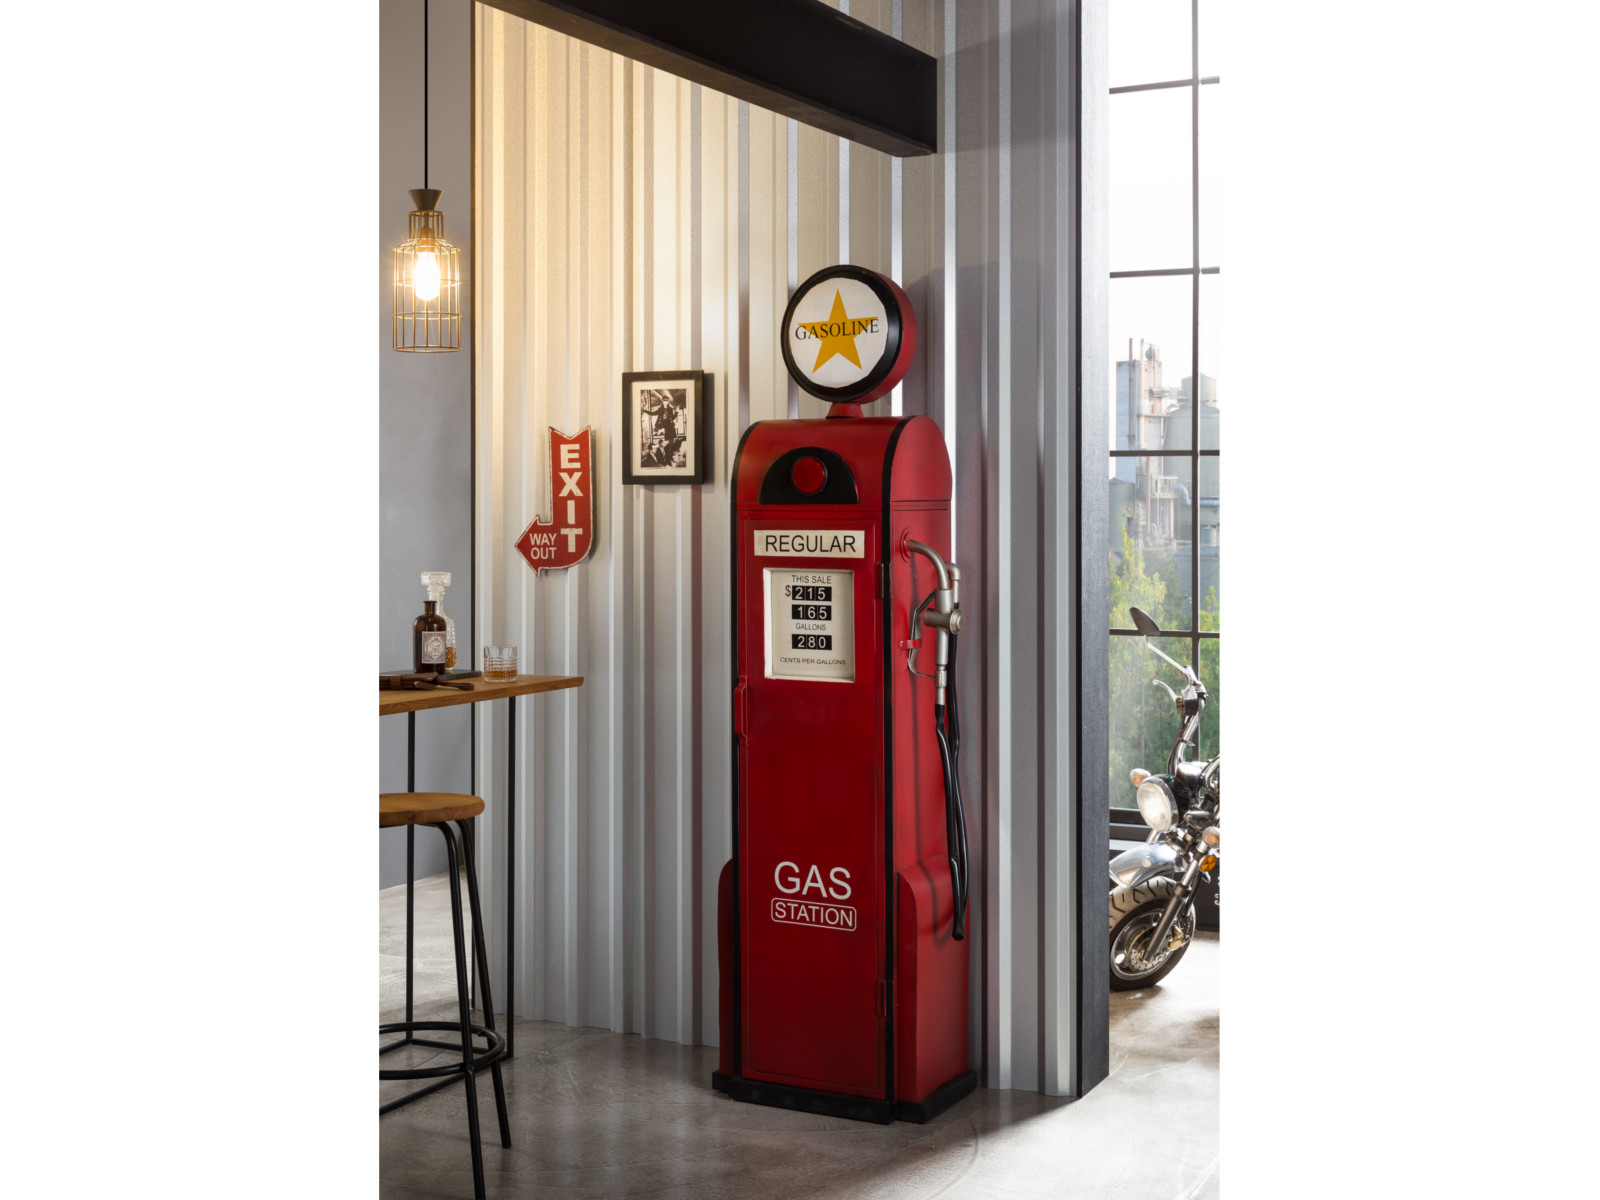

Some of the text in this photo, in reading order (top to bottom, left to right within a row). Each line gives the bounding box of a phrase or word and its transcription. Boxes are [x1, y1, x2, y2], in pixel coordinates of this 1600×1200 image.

[795, 318, 879, 340] GASOLINE
[558, 443, 584, 553] EXIT
[529, 533, 557, 546] WAY
[765, 534, 856, 553] REGULAR
[530, 547, 557, 560] OUT
[791, 574, 832, 584] THIS SALE
[797, 605, 828, 620] 165
[795, 622, 827, 631] GALLONS
[797, 635, 827, 649] 280
[779, 656, 847, 666] CENTS PER GALLONS
[774, 860, 852, 900] GAS
[774, 901, 853, 927] STATION
